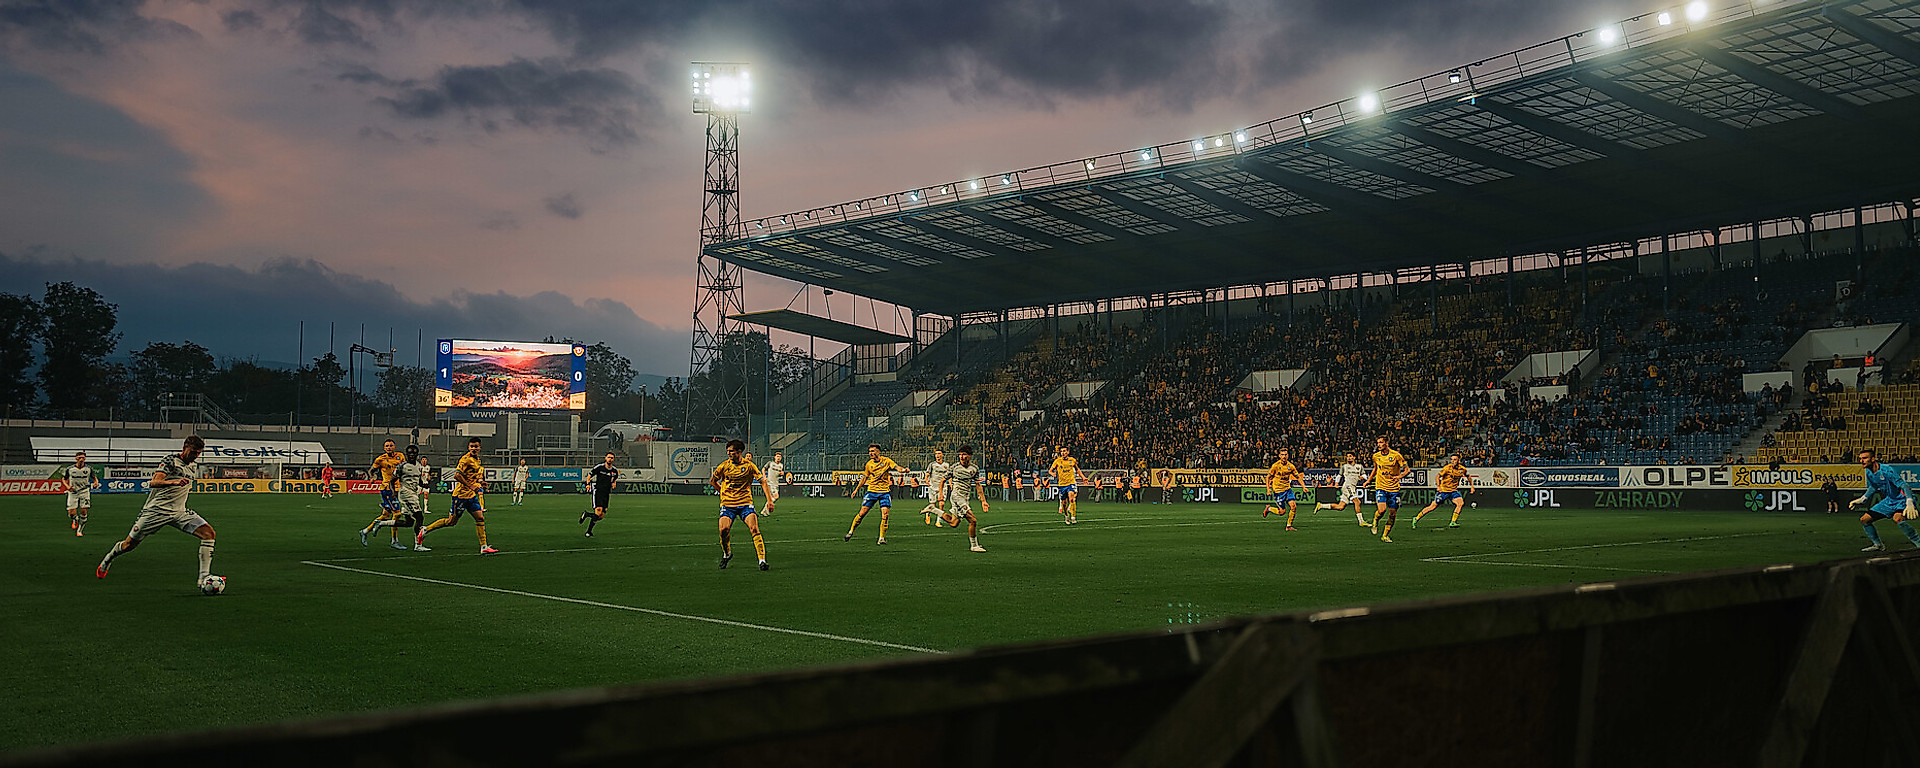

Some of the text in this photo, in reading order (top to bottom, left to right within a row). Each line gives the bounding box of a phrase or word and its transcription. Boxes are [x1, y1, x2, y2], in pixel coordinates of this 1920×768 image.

[441, 368, 448, 379] 1
[574, 371, 582, 382] 0
[1222, 474, 1268, 484] DRESDEN
[1548, 474, 1606, 482] KOVOSREAL
[1643, 467, 1729, 486] OLPE
[1750, 469, 1813, 485] IMPULS
[190, 480, 255, 493] hance
[624, 483, 673, 493] ZAHRADY
[809, 485, 825, 497] JPL
[1194, 487, 1219, 502] JPL
[1529, 489, 1561, 507] JPL
[1594, 491, 1684, 508] ZAHRADY
[1764, 490, 1806, 512] JPL
